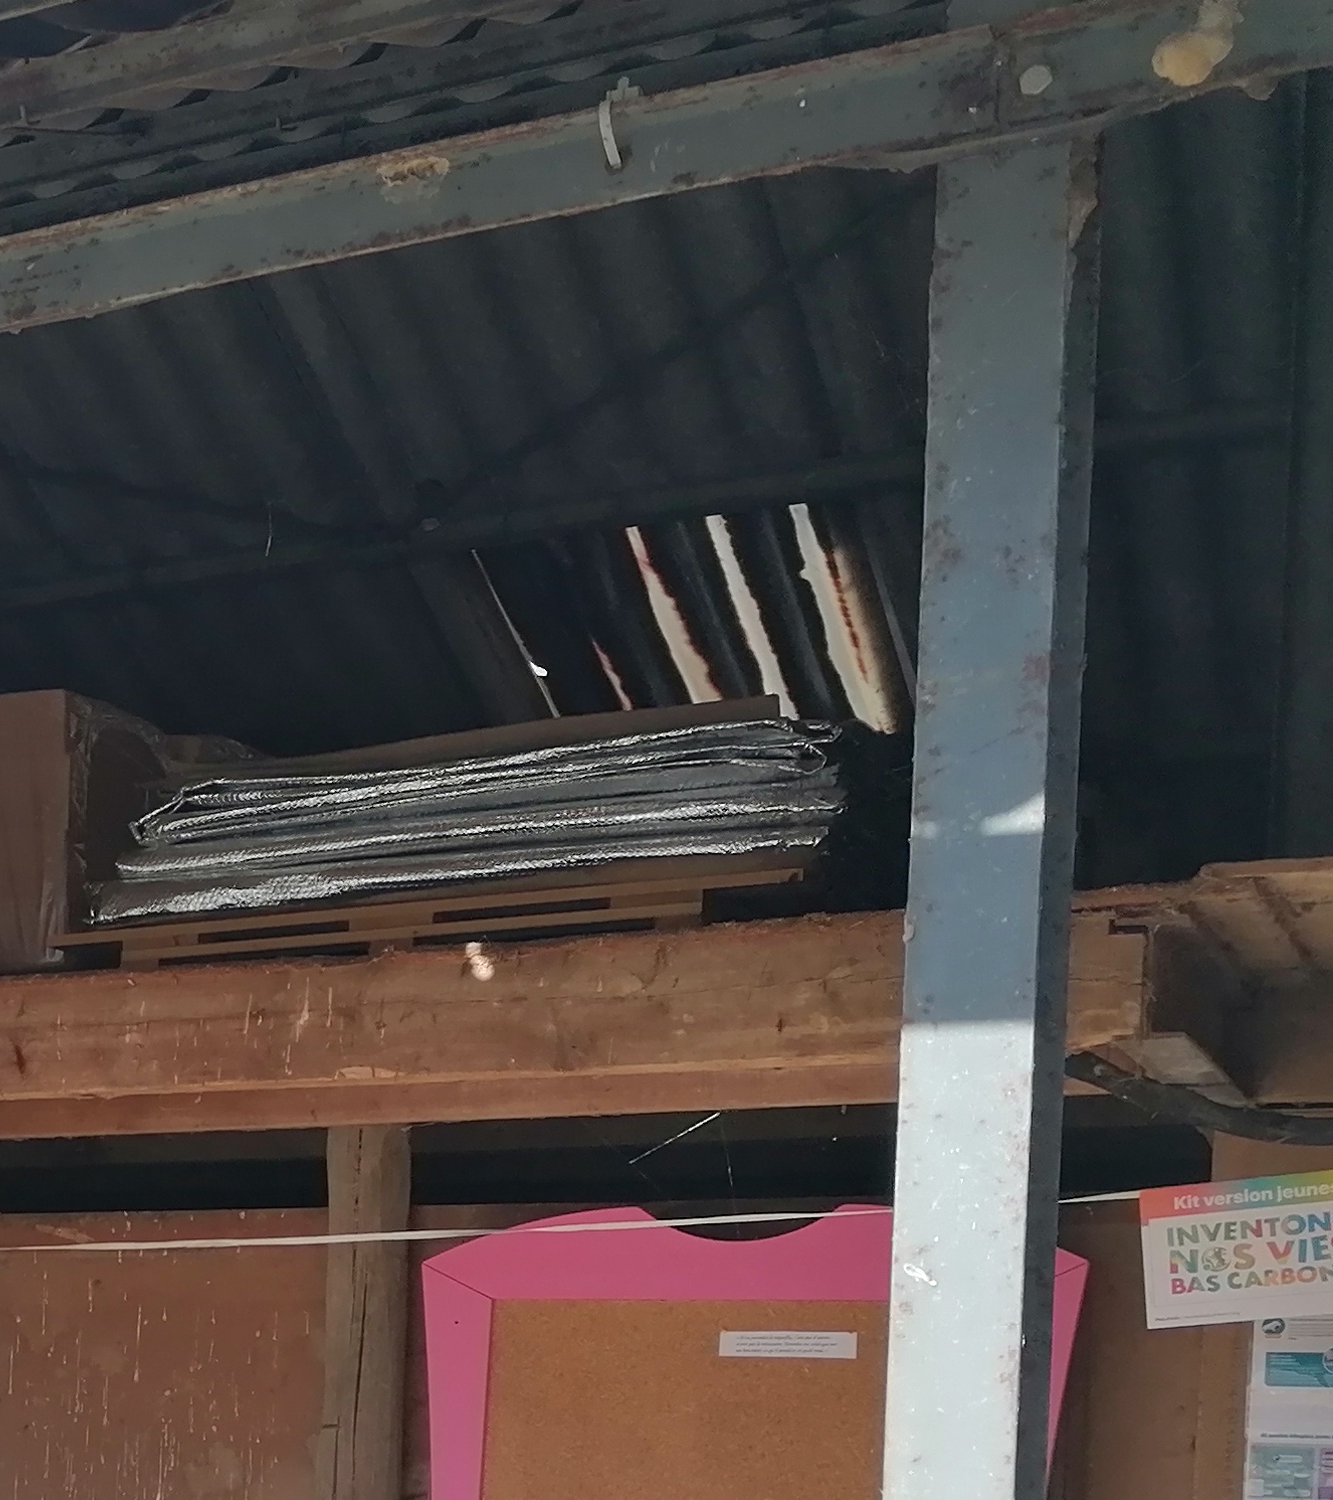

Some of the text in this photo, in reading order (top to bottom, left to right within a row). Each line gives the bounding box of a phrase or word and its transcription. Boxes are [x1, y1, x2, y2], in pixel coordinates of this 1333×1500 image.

[1173, 1183, 1333, 1210] Kit version jeune
[1166, 1211, 1333, 1247] INVENTON
[1169, 1234, 1333, 1274] NOS VIE
[1171, 1275, 1221, 1295] BAS
